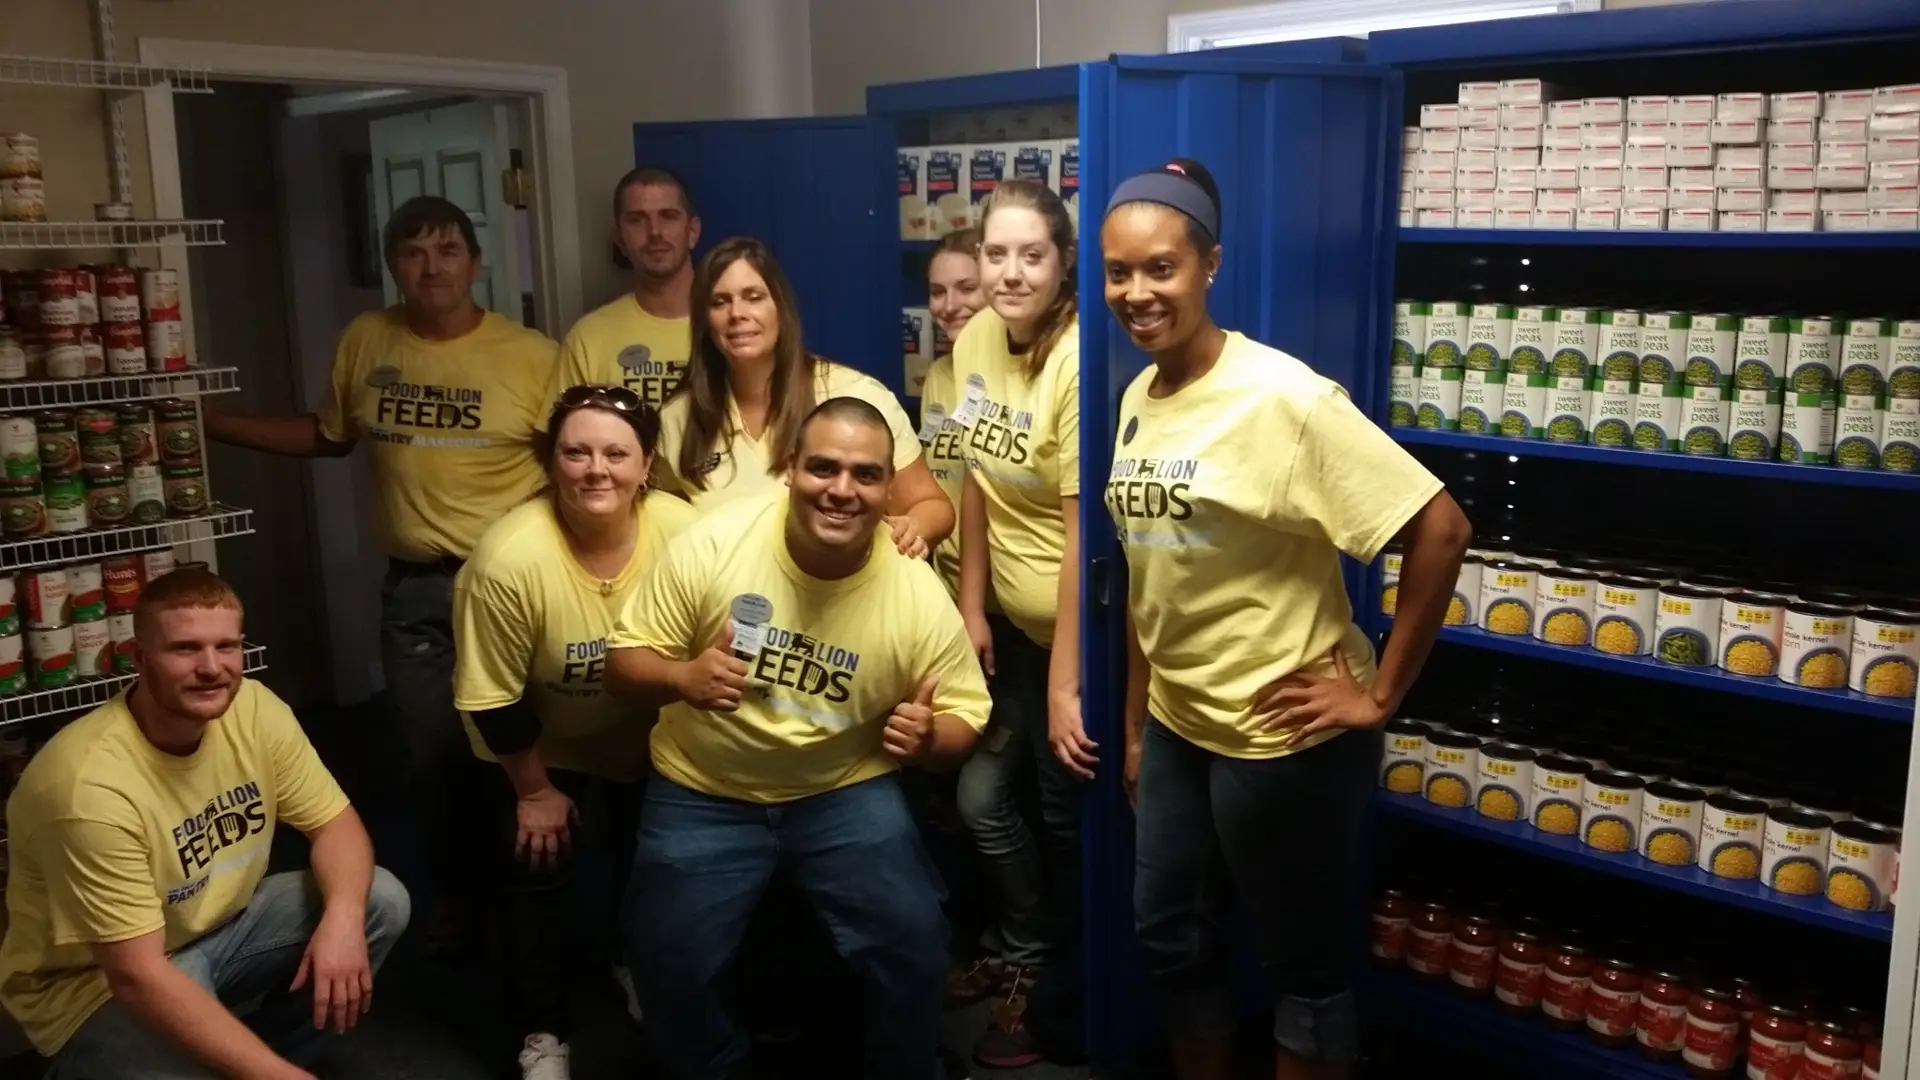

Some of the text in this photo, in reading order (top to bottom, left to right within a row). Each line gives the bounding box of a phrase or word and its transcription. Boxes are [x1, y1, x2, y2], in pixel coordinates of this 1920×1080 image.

[1432, 328, 1457, 338] peas
[1472, 331, 1496, 340] peas
[1516, 334, 1542, 344] peas
[1558, 336, 1585, 346] peas
[1611, 339, 1638, 349] peas
[1644, 342, 1669, 352] peas
[1690, 344, 1716, 354] peas
[1741, 346, 1769, 357] peas
[1800, 350, 1830, 360] peas
[1848, 350, 1879, 362] peas
[1896, 353, 1920, 364] pea
[381, 382, 482, 404] FOOD LION
[1555, 402, 1582, 413] peas
[1601, 406, 1628, 417] peas
[378, 398, 482, 430] FEEDS
[1691, 413, 1720, 424] peas
[1737, 417, 1766, 428] peas
[1890, 420, 1916, 428] sweet
[1844, 423, 1874, 434] peas
[1888, 427, 1919, 439] peas
[1156, 459, 1198, 480] LION
[1108, 481, 1193, 521] FEEDS
[1730, 621, 1751, 631] kernel
[1802, 634, 1828, 643] kernel
[566, 637, 606, 660] FOOD
[766, 627, 790, 648] OD
[816, 642, 860, 672] LION
[1868, 641, 1894, 651] kernel
[217, 782, 262, 812] LION
[1591, 800, 1612, 811] kernel
[1650, 812, 1672, 824] kernel
[1716, 826, 1739, 837] kernel
[178, 800, 266, 880] FEEDS
[1777, 840, 1800, 852] kernel
